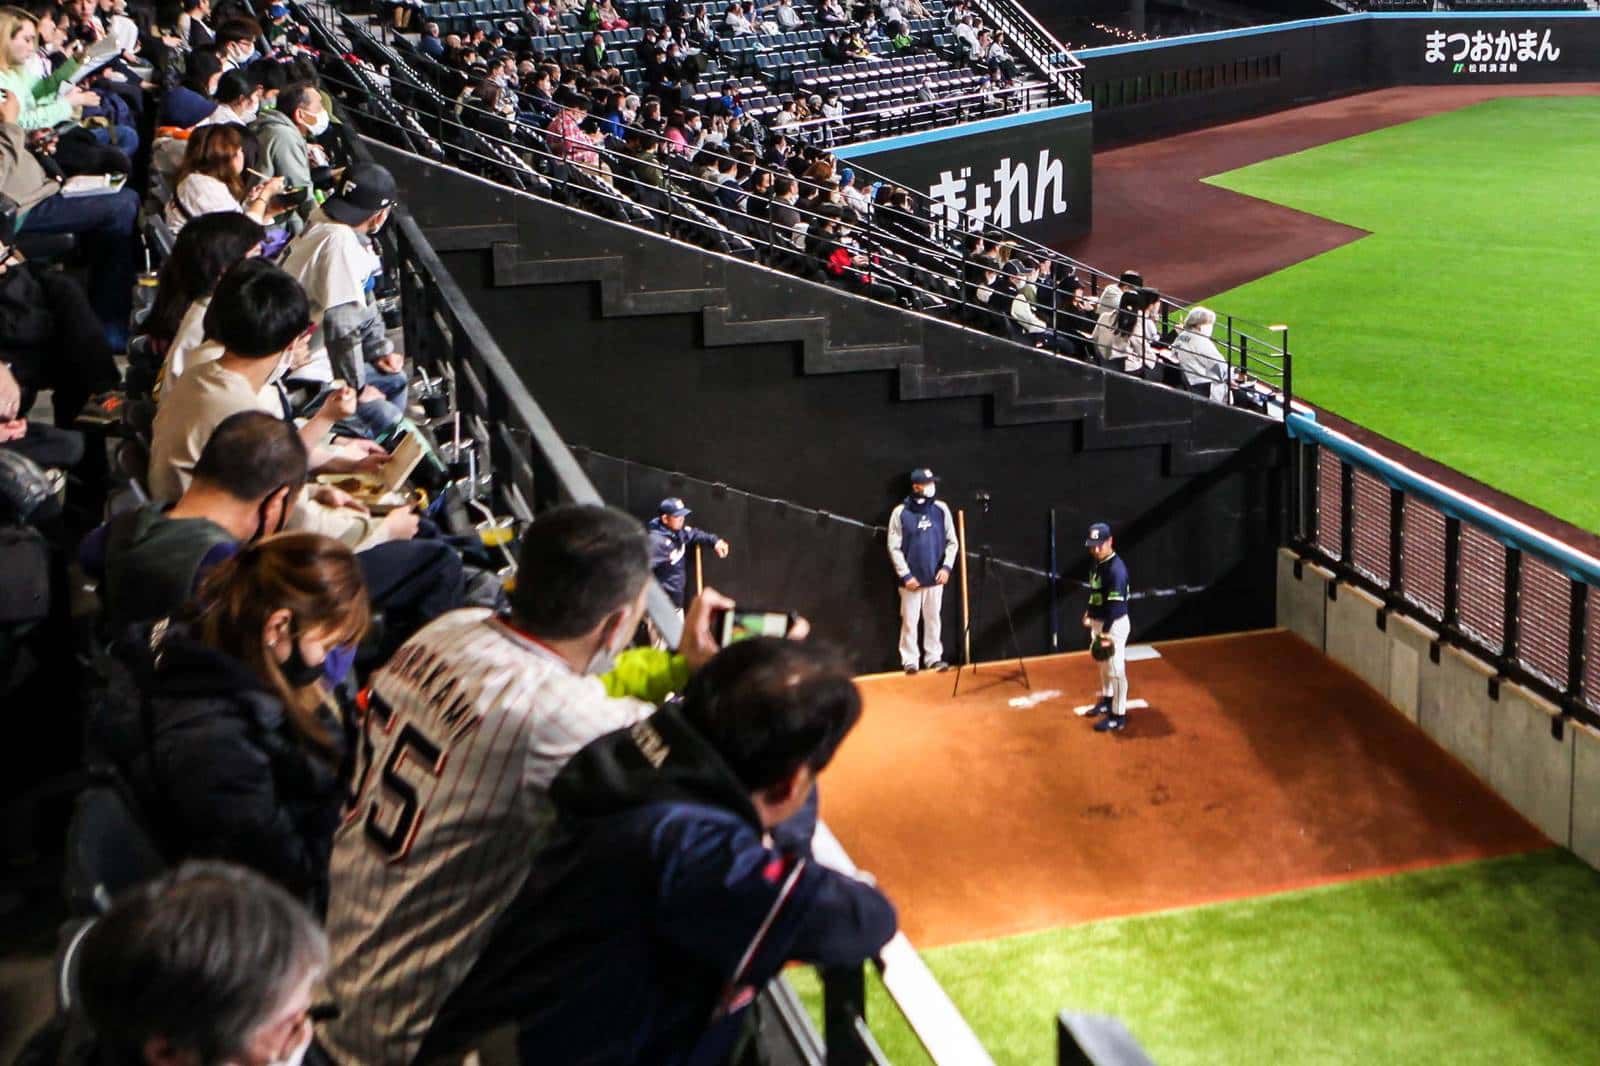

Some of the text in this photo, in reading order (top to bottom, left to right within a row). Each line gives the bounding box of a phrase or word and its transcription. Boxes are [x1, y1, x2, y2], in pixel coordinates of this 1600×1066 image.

[1425, 29, 1561, 62] まつおかまん
[929, 149, 1067, 230] ぎょれん
